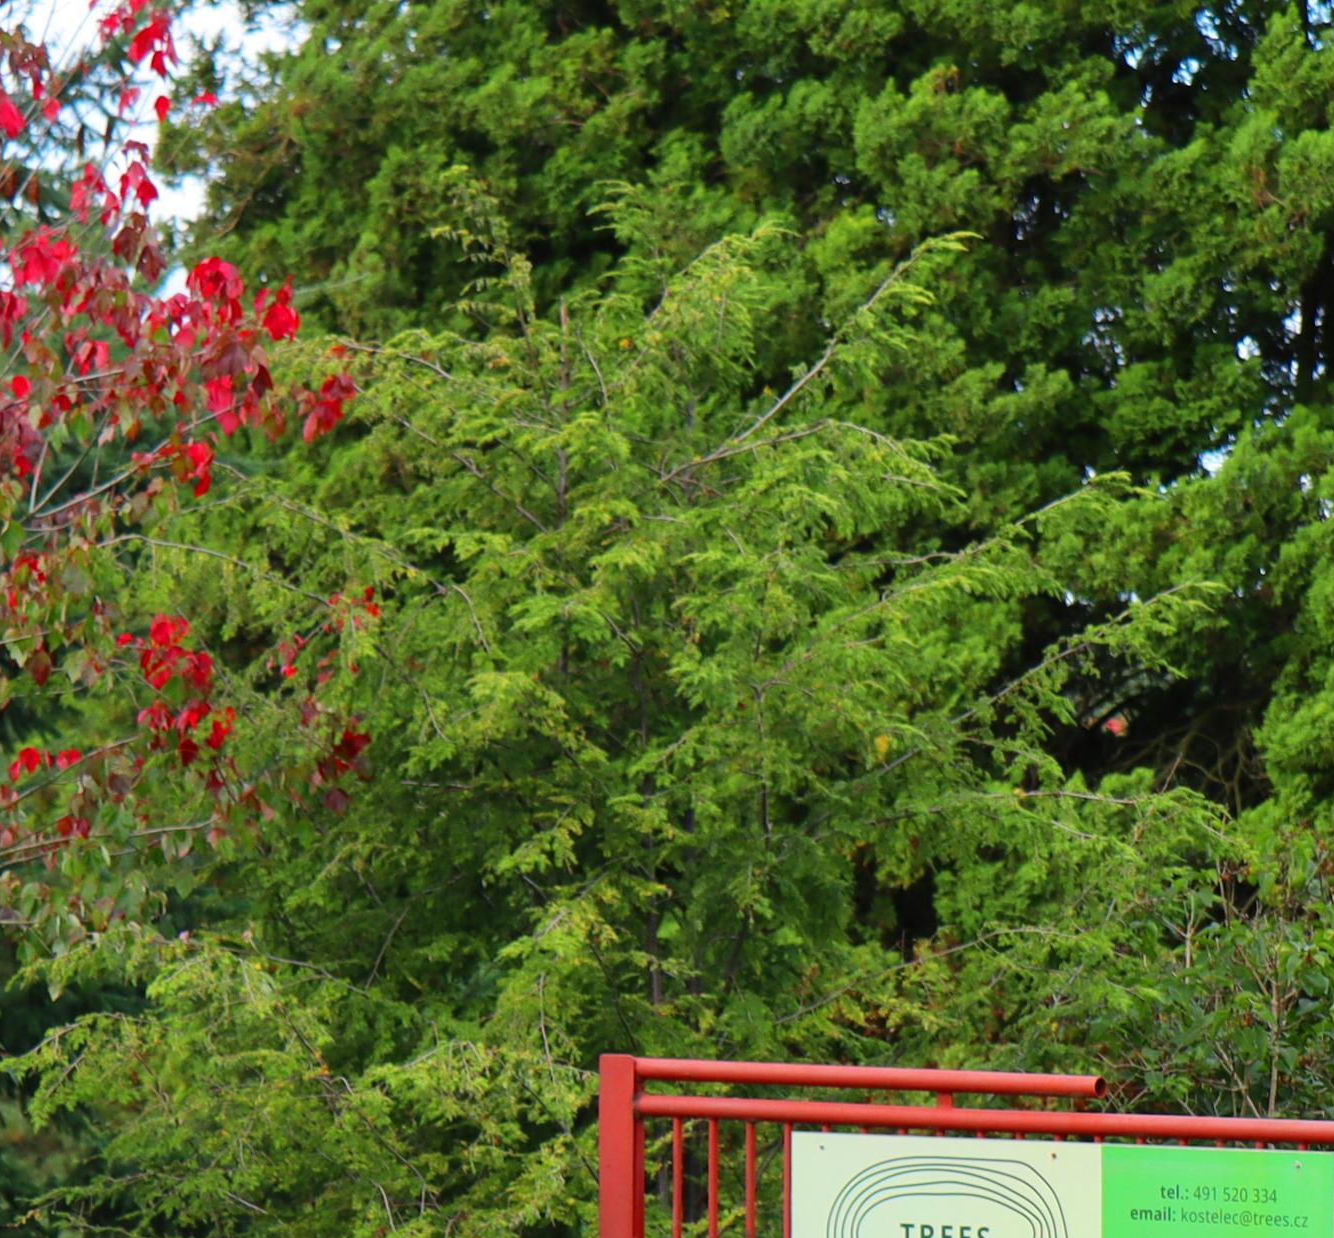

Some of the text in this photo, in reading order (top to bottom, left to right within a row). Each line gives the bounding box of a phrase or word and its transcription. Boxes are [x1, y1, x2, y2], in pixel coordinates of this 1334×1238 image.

[1160, 1184, 1278, 1203] tel.: 491 520 334
[1130, 1207, 1309, 1229] email: kostelec@trees.cz
